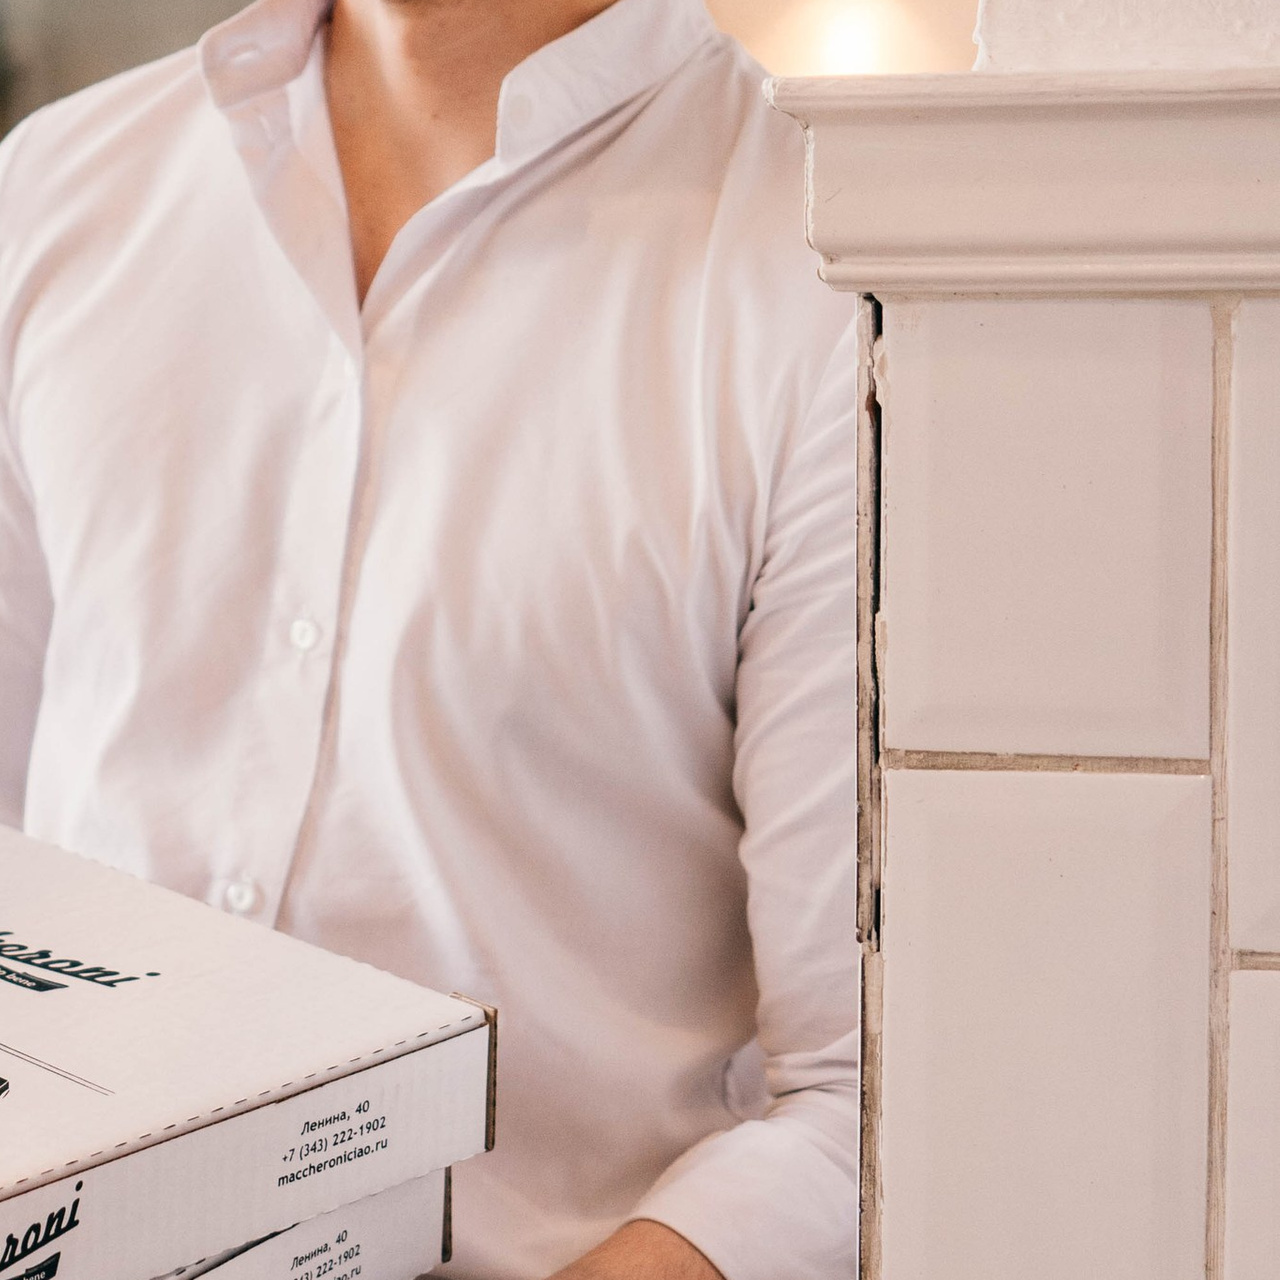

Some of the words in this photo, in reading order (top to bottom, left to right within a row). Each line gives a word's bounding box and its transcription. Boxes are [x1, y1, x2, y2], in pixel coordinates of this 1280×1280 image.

[5, 971, 36, 988] bene
[300, 1111, 351, 1136] Ленина,
[355, 1100, 370, 1114] 40
[282, 1148, 295, 1162] +7
[299, 1137, 328, 1161] (343)
[332, 1116, 386, 1147] 222-1902
[277, 1138, 388, 1187] maccheroniciao.ru
[290, 1243, 332, 1271] Ленина,
[335, 1229, 348, 1245] 40
[316, 1244, 360, 1278] 222-1902
